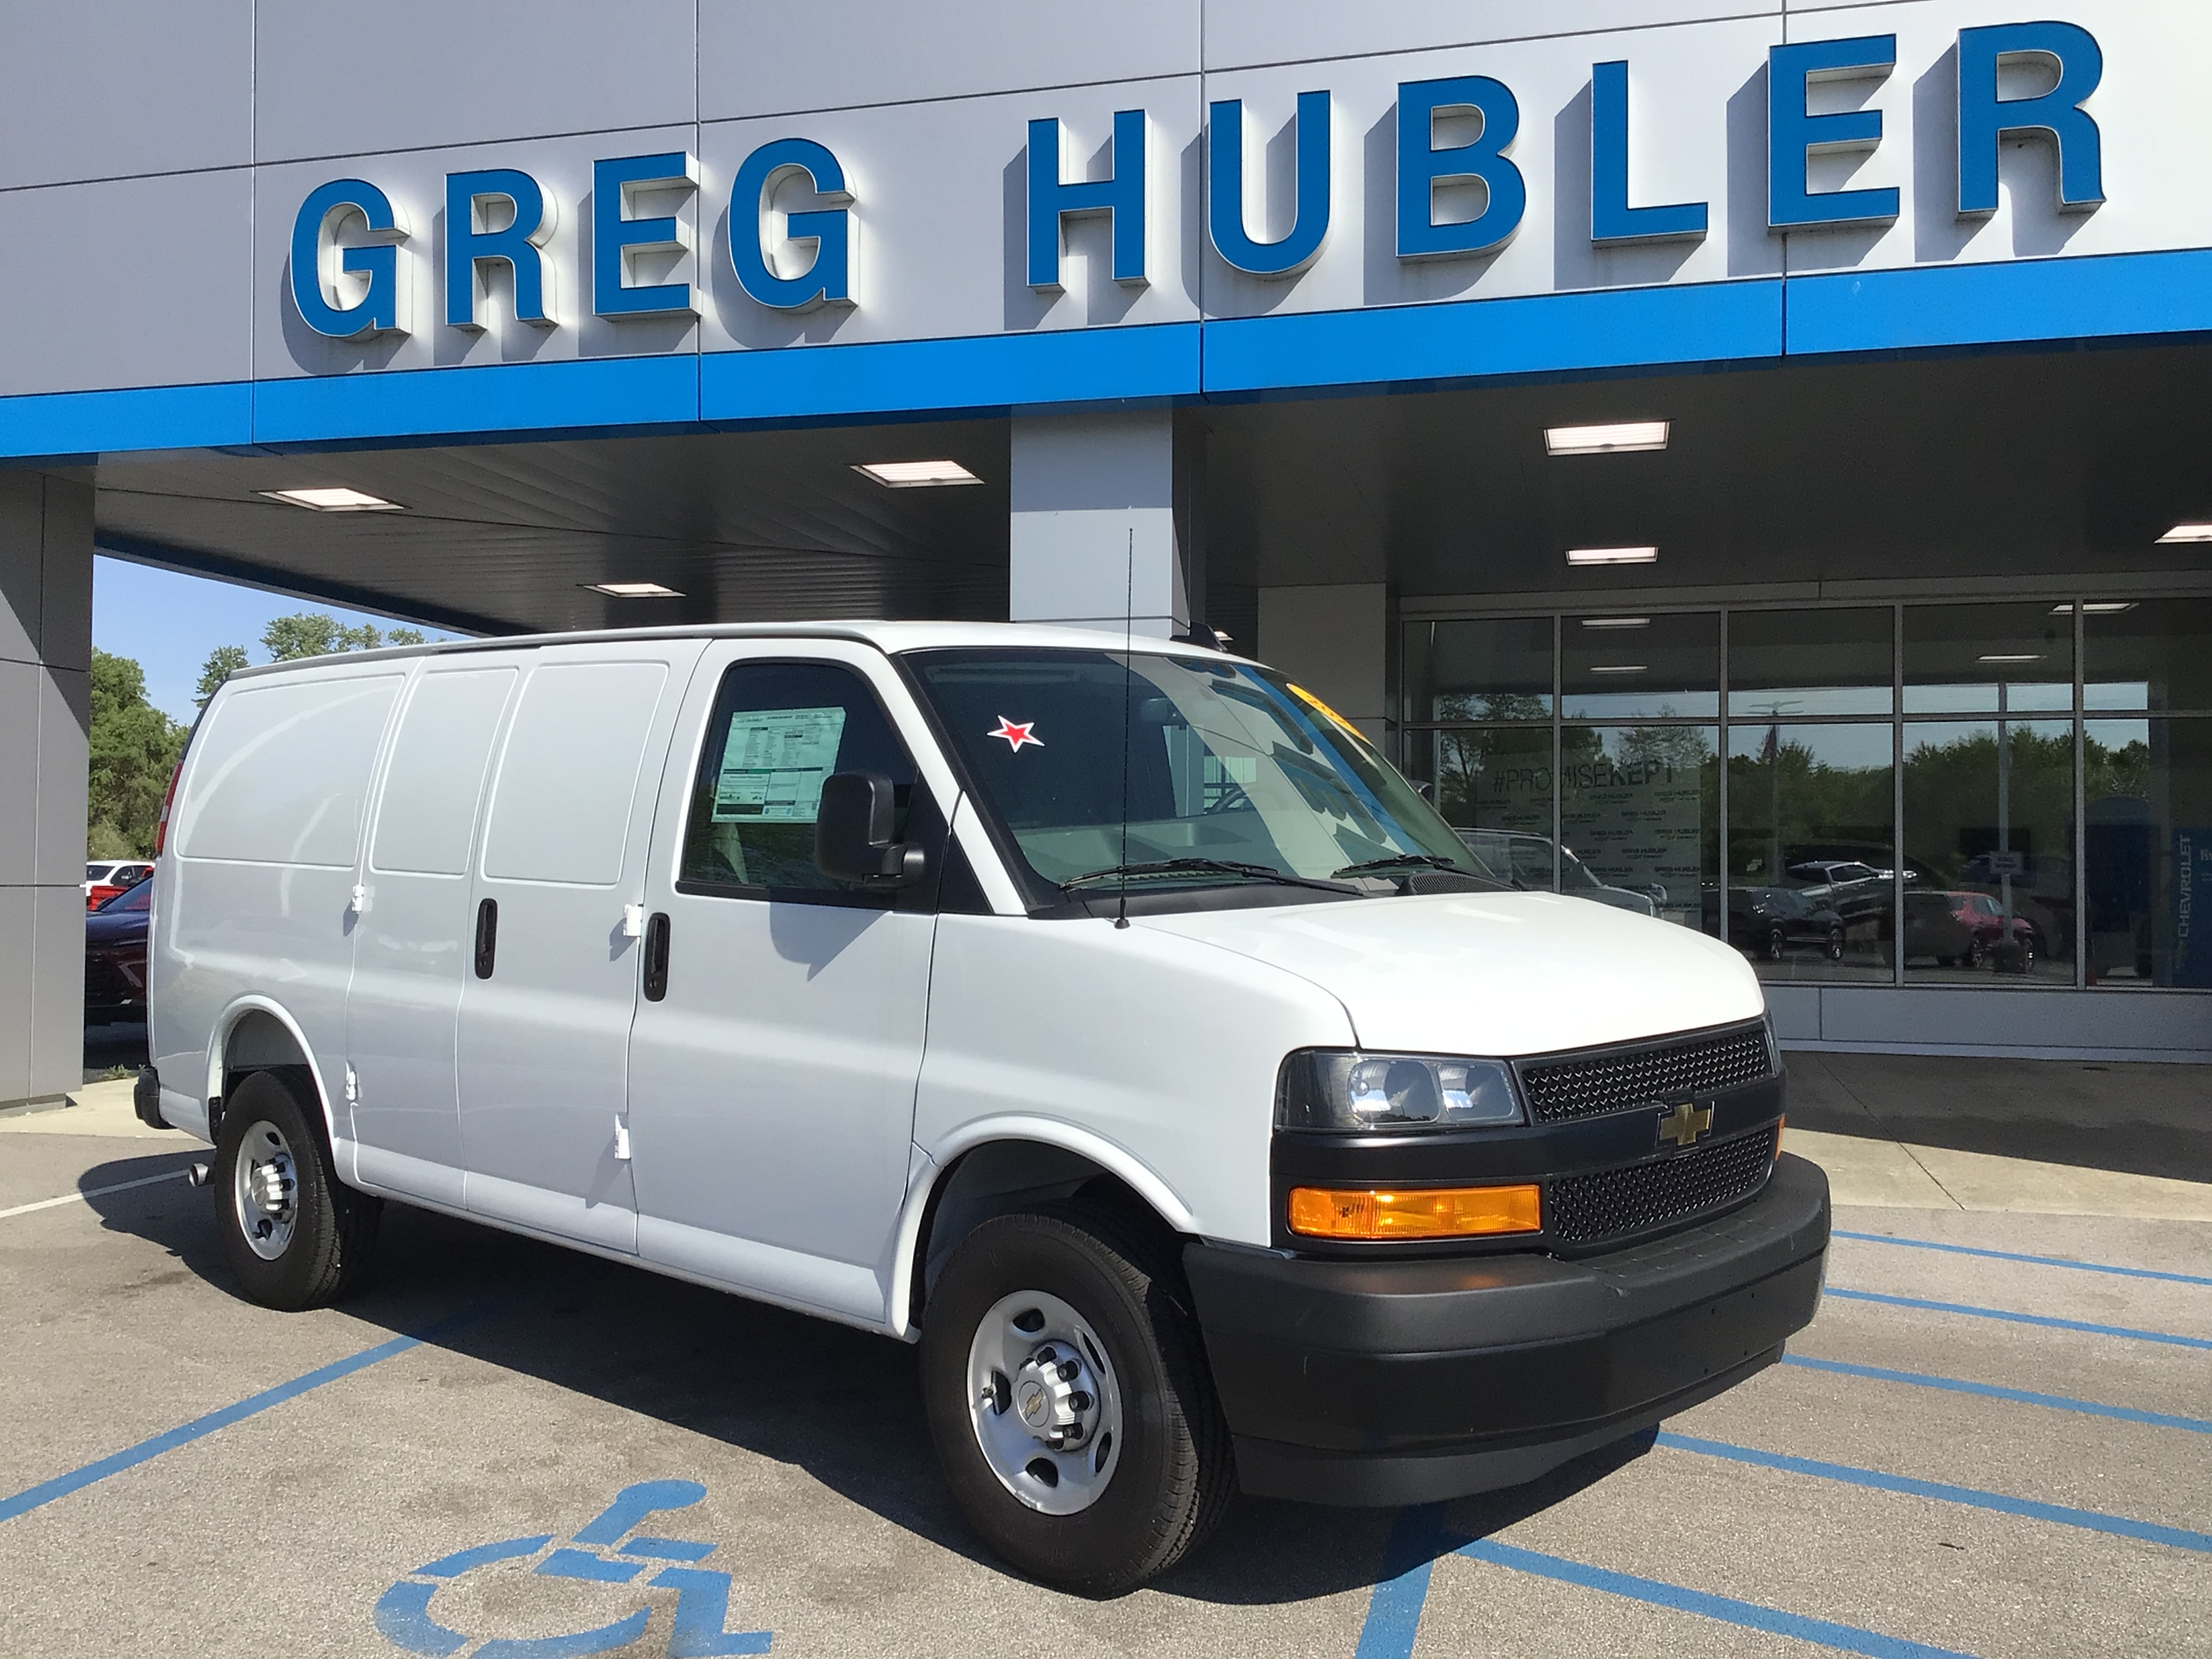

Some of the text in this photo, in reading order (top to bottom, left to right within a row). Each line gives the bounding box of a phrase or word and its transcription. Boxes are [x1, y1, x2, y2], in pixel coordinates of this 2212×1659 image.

[290, 20, 2106, 339] GREG HUBLER
[2177, 834, 2192, 937] CHEVROLET
